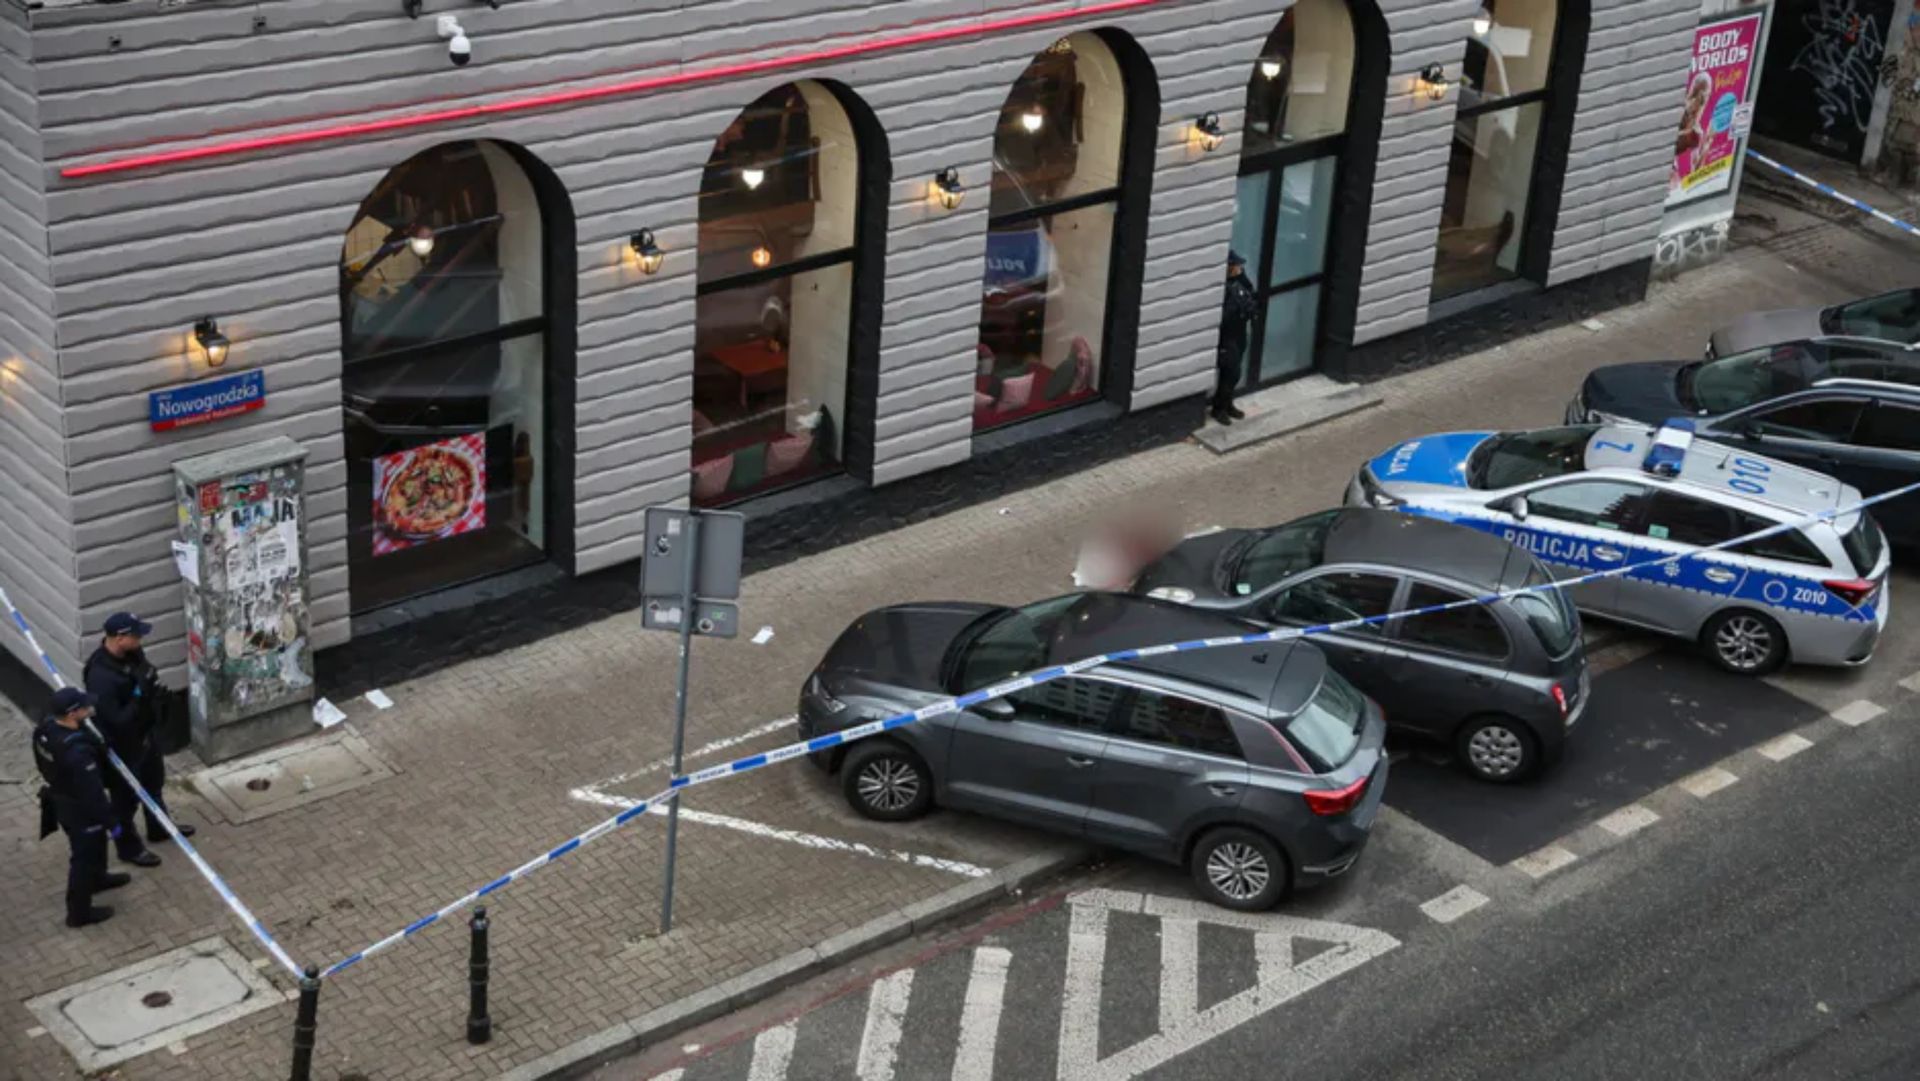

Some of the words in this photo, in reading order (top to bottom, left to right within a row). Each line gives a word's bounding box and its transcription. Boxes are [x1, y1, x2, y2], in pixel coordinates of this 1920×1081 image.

[1699, 28, 1742, 53] BODY
[158, 383, 259, 416] Nowogrodzka
[1504, 529, 1590, 562] POLICJA
[1792, 586, 1828, 606] Z010
